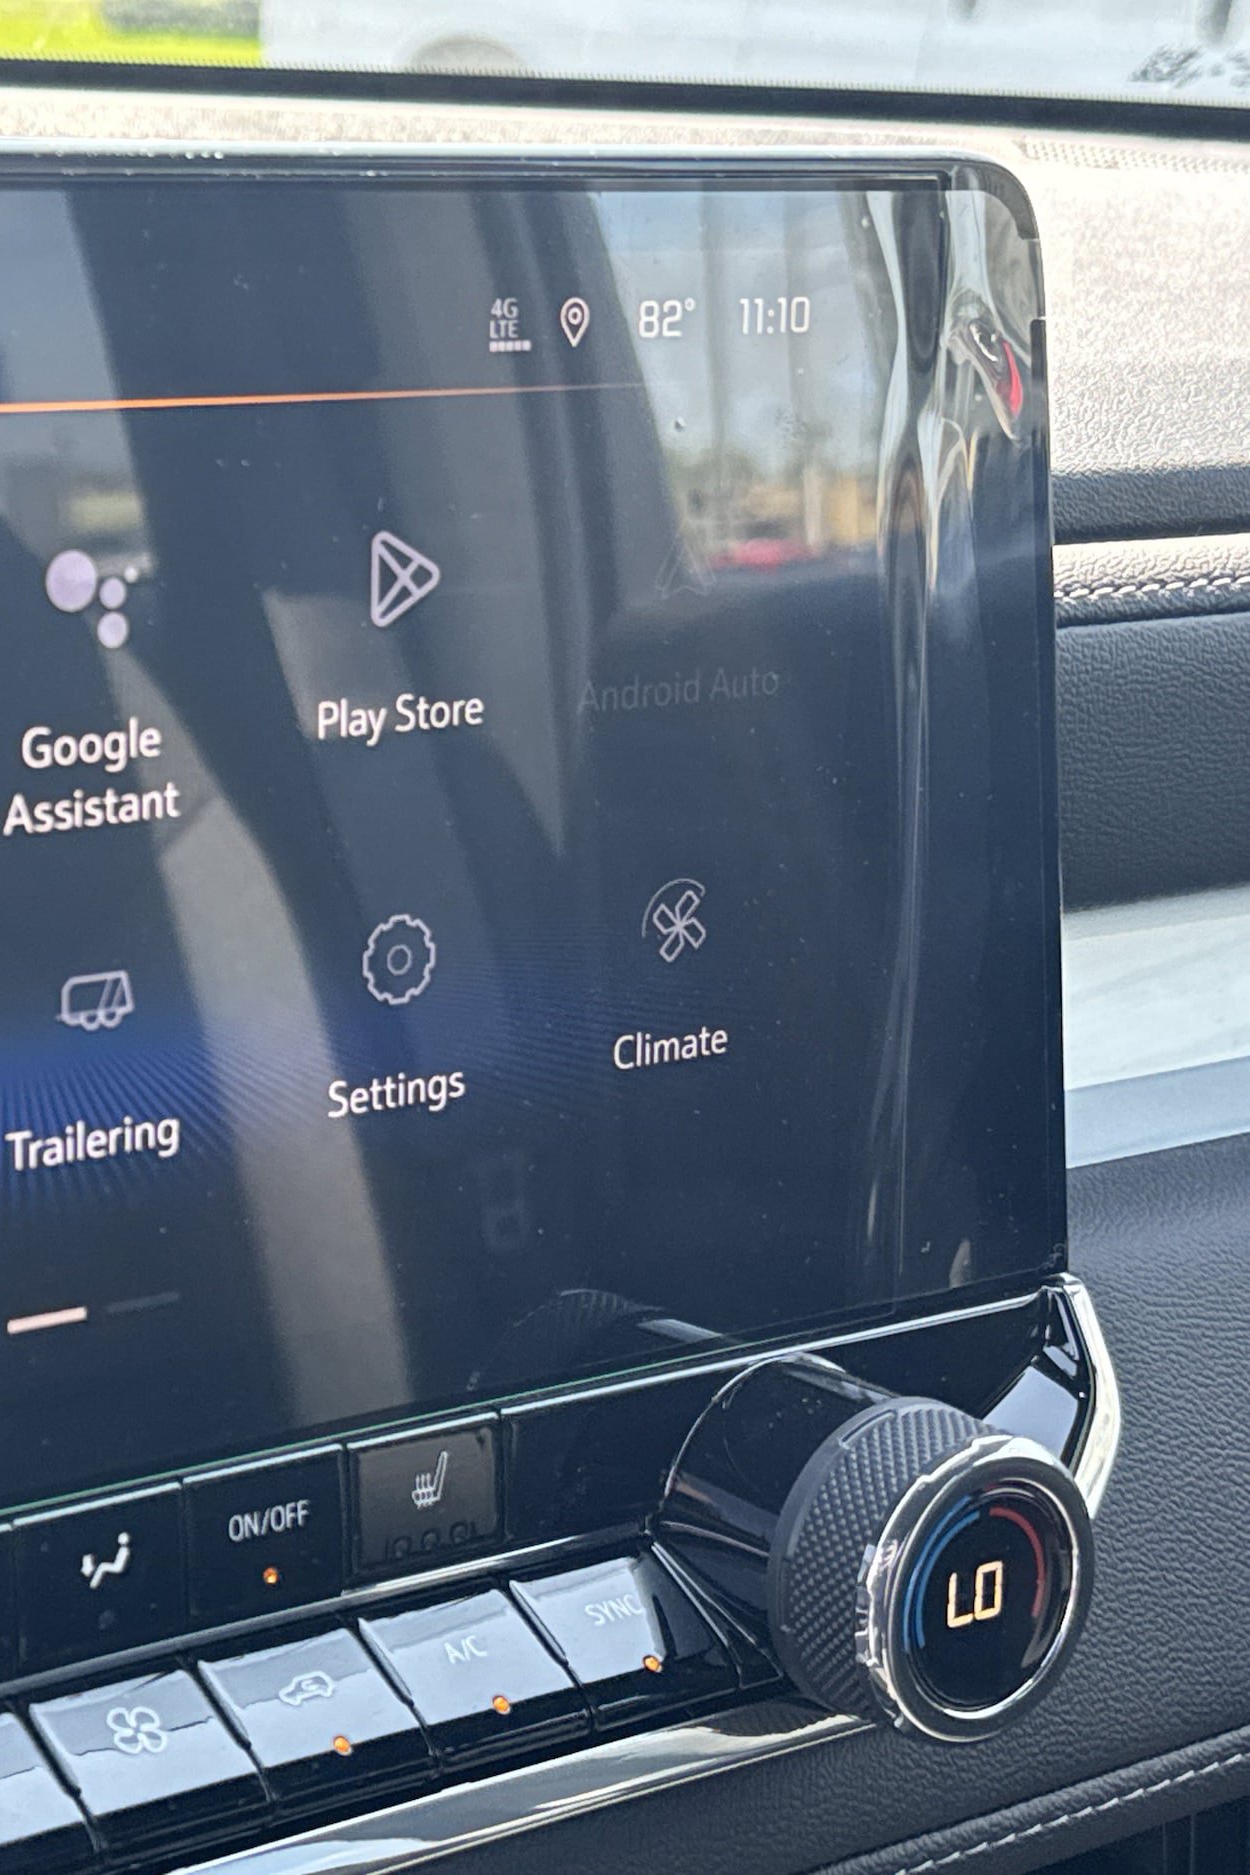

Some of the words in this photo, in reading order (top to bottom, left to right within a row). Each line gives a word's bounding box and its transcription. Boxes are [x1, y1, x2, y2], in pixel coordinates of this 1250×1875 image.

[489, 297, 519, 320] 4G
[489, 319, 519, 340] LTE
[738, 297, 811, 335] 11:10
[577, 669, 700, 714] Android
[710, 666, 781, 702] Auto
[316, 699, 387, 747] Play
[394, 694, 485, 735] Store
[20, 716, 163, 773] Google
[2, 780, 182, 836] Assistant
[612, 1025, 729, 1071] Climate
[327, 1068, 467, 1118] Settings
[5, 1112, 181, 1173] Trailering
[228, 1498, 310, 1543] ON/OFF
[584, 1592, 642, 1627] SYNC
[947, 1560, 1004, 1628] LO
[443, 1634, 488, 1664] A/C
